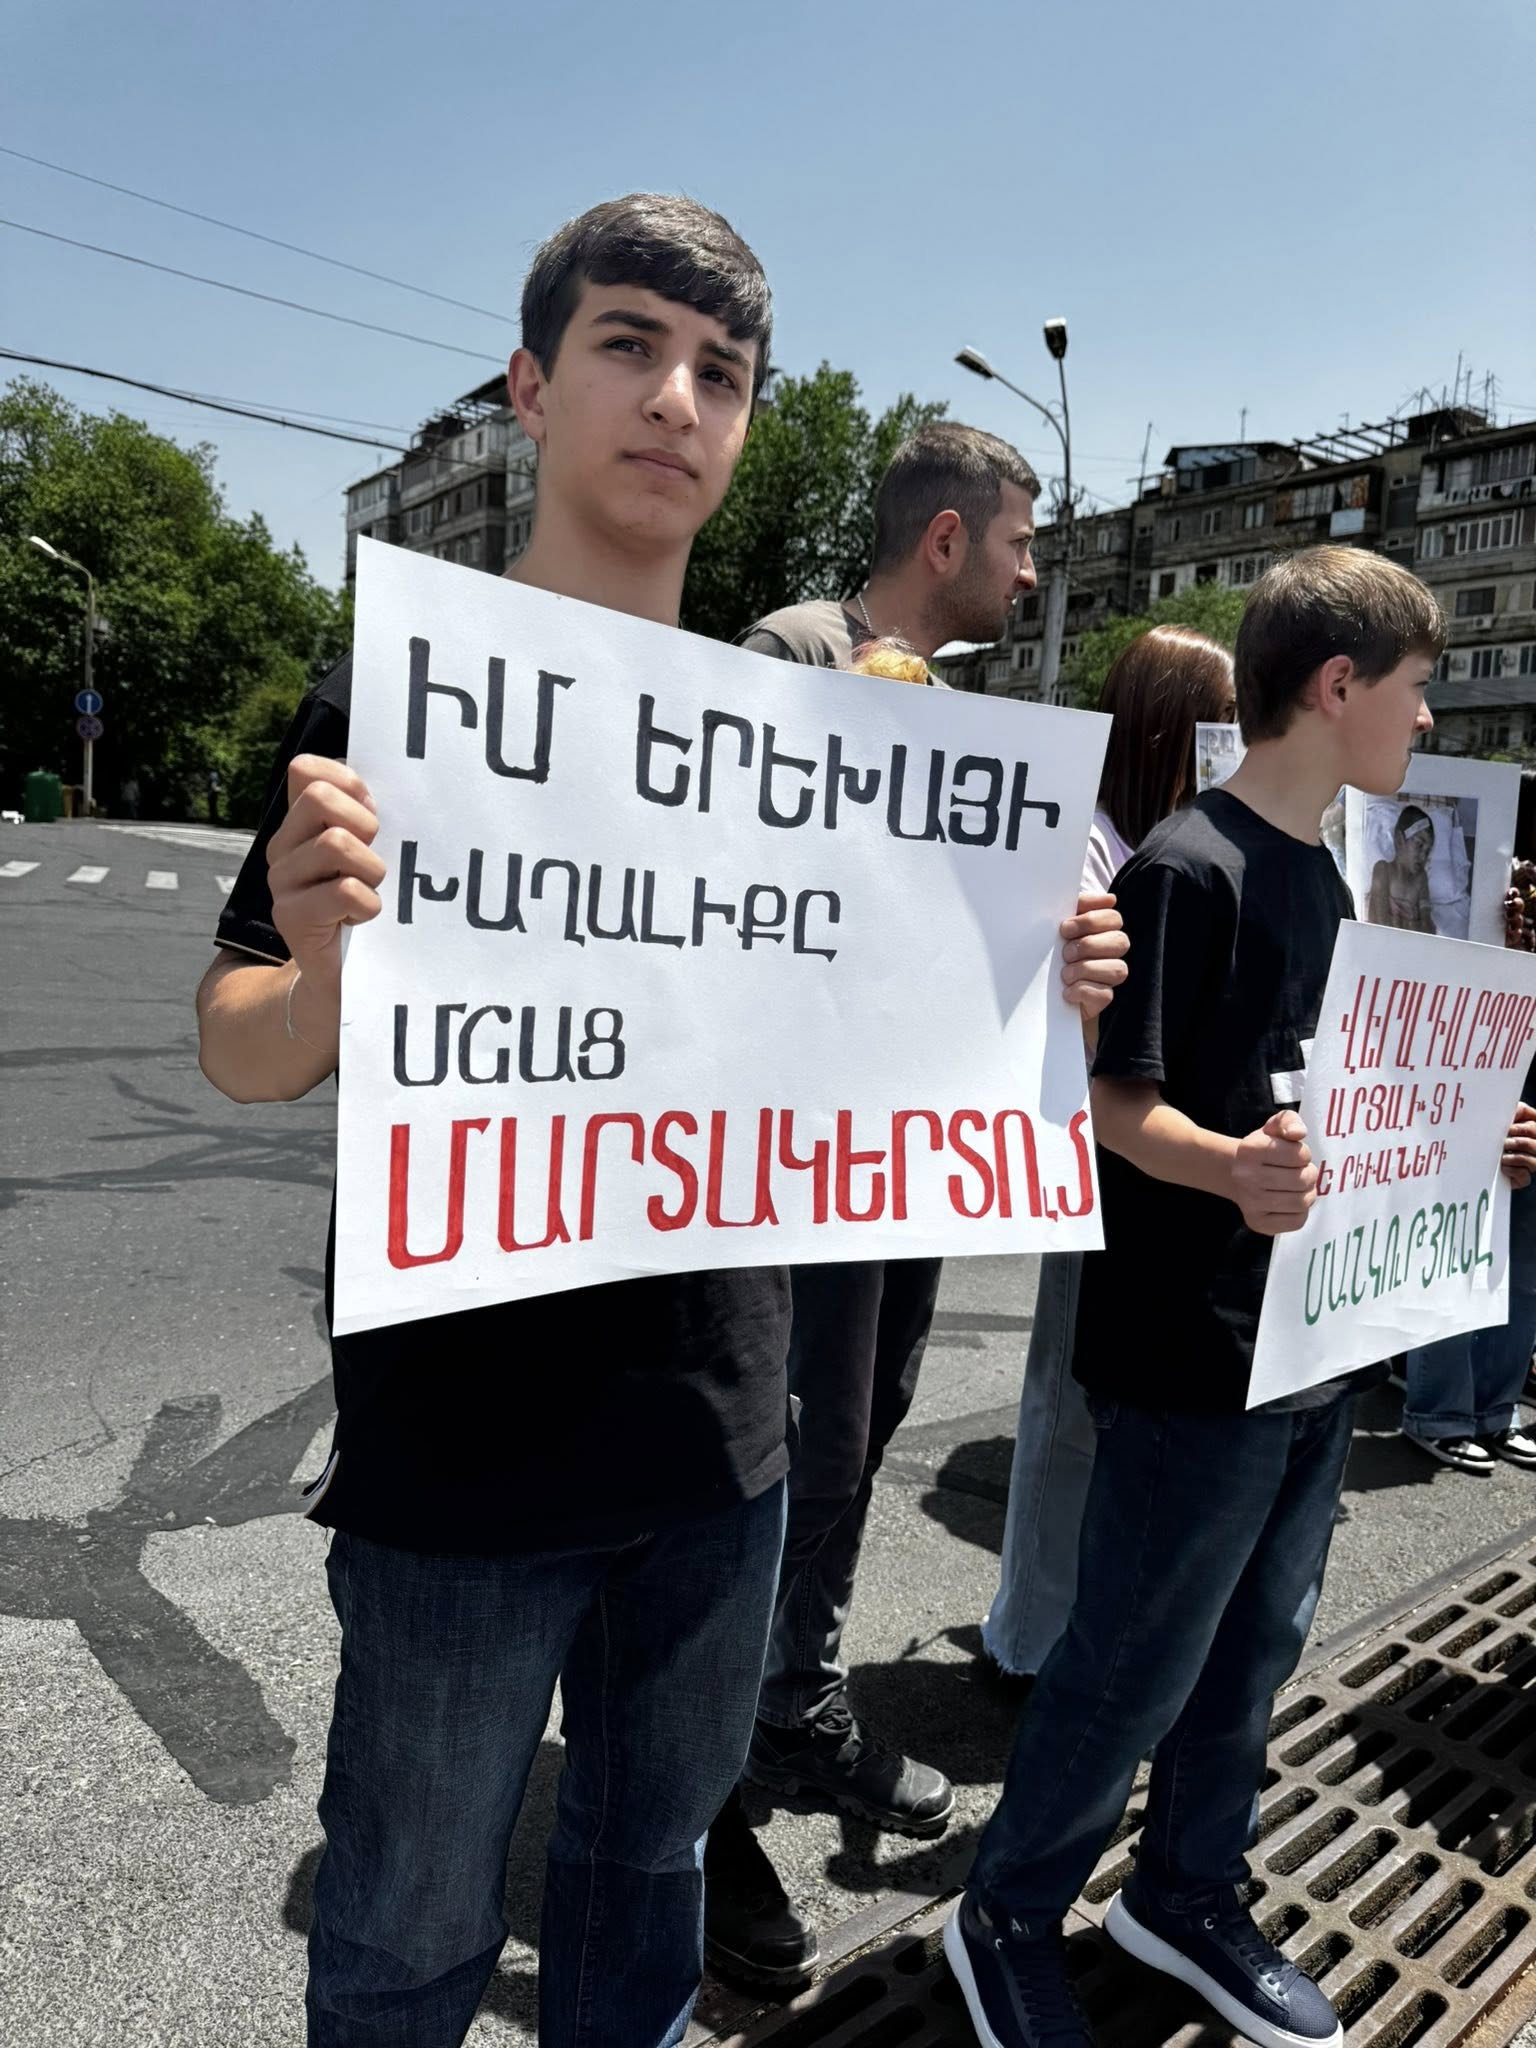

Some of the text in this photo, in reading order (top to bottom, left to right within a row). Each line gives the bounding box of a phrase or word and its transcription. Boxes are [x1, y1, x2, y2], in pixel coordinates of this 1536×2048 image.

[405, 636, 1061, 852] ԻՄ ԵՐԵԽԱՅԻ
[398, 840, 842, 963] ԽԱՂԱԼԻՔԸ
